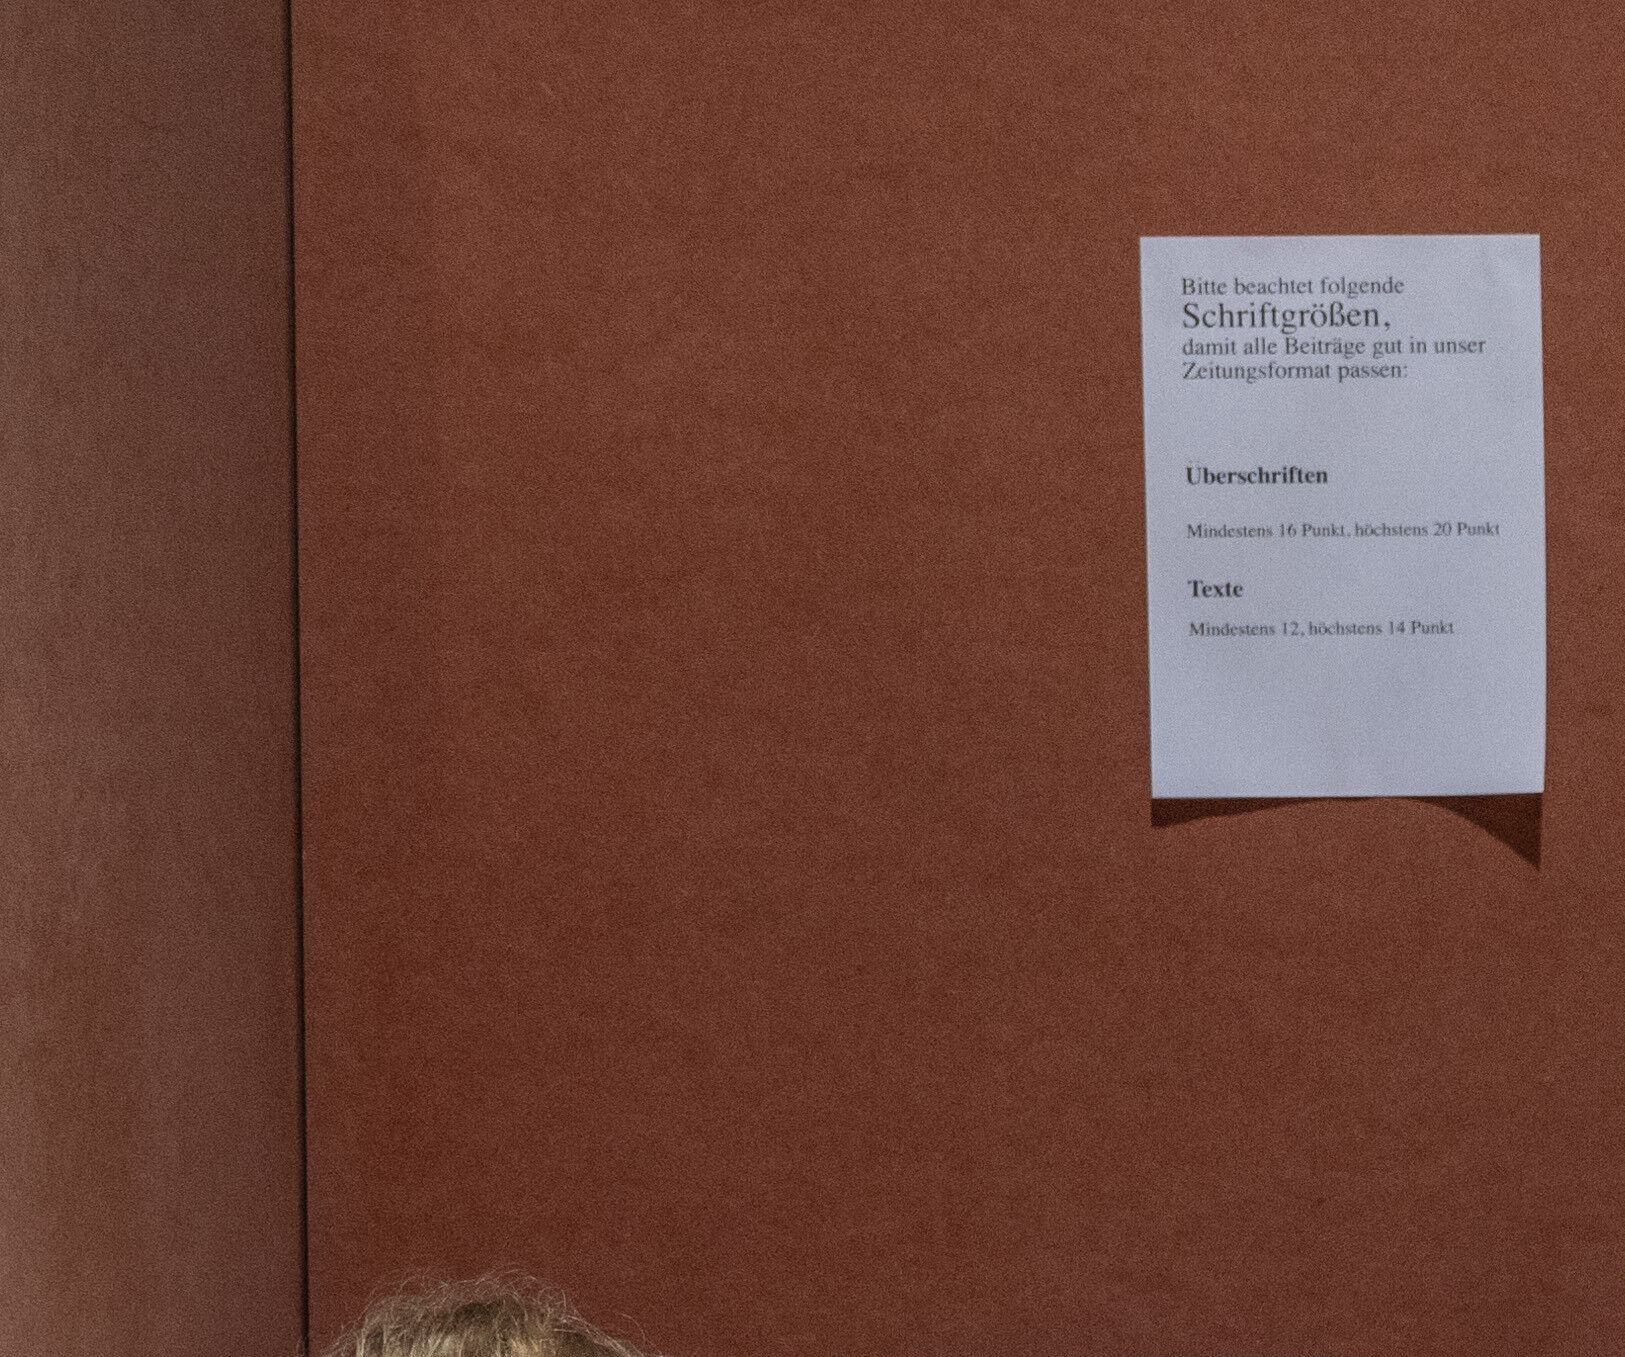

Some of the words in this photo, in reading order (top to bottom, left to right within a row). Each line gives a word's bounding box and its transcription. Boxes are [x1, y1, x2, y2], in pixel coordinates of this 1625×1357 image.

[1181, 276, 1228, 296] Bitte
[1233, 276, 1314, 296] beachtet
[1320, 275, 1405, 298] folgende
[1182, 300, 1391, 334] Schriftgrößen,
[1181, 337, 1237, 357] damit
[1242, 336, 1278, 356] alle
[1284, 336, 1366, 359] Beiträge
[1371, 338, 1403, 358] gut
[1409, 335, 1428, 354] in
[1433, 340, 1487, 354] unser
[1182, 361, 1331, 383] Zeitungsformat
[1337, 364, 1408, 382] passen:
[1186, 522, 1274, 540] Mindestens
[1279, 522, 1298, 538] 16
[1354, 522, 1429, 538] höchstens
[1433, 521, 1453, 537] 20
[1456, 521, 1500, 536] Punkt
[1187, 579, 1244, 599] Texte
[1189, 621, 1277, 638] Mindestens
[1308, 620, 1383, 637] höchstens
[1389, 619, 1406, 635] 14
[1410, 619, 1455, 635] Punkt
